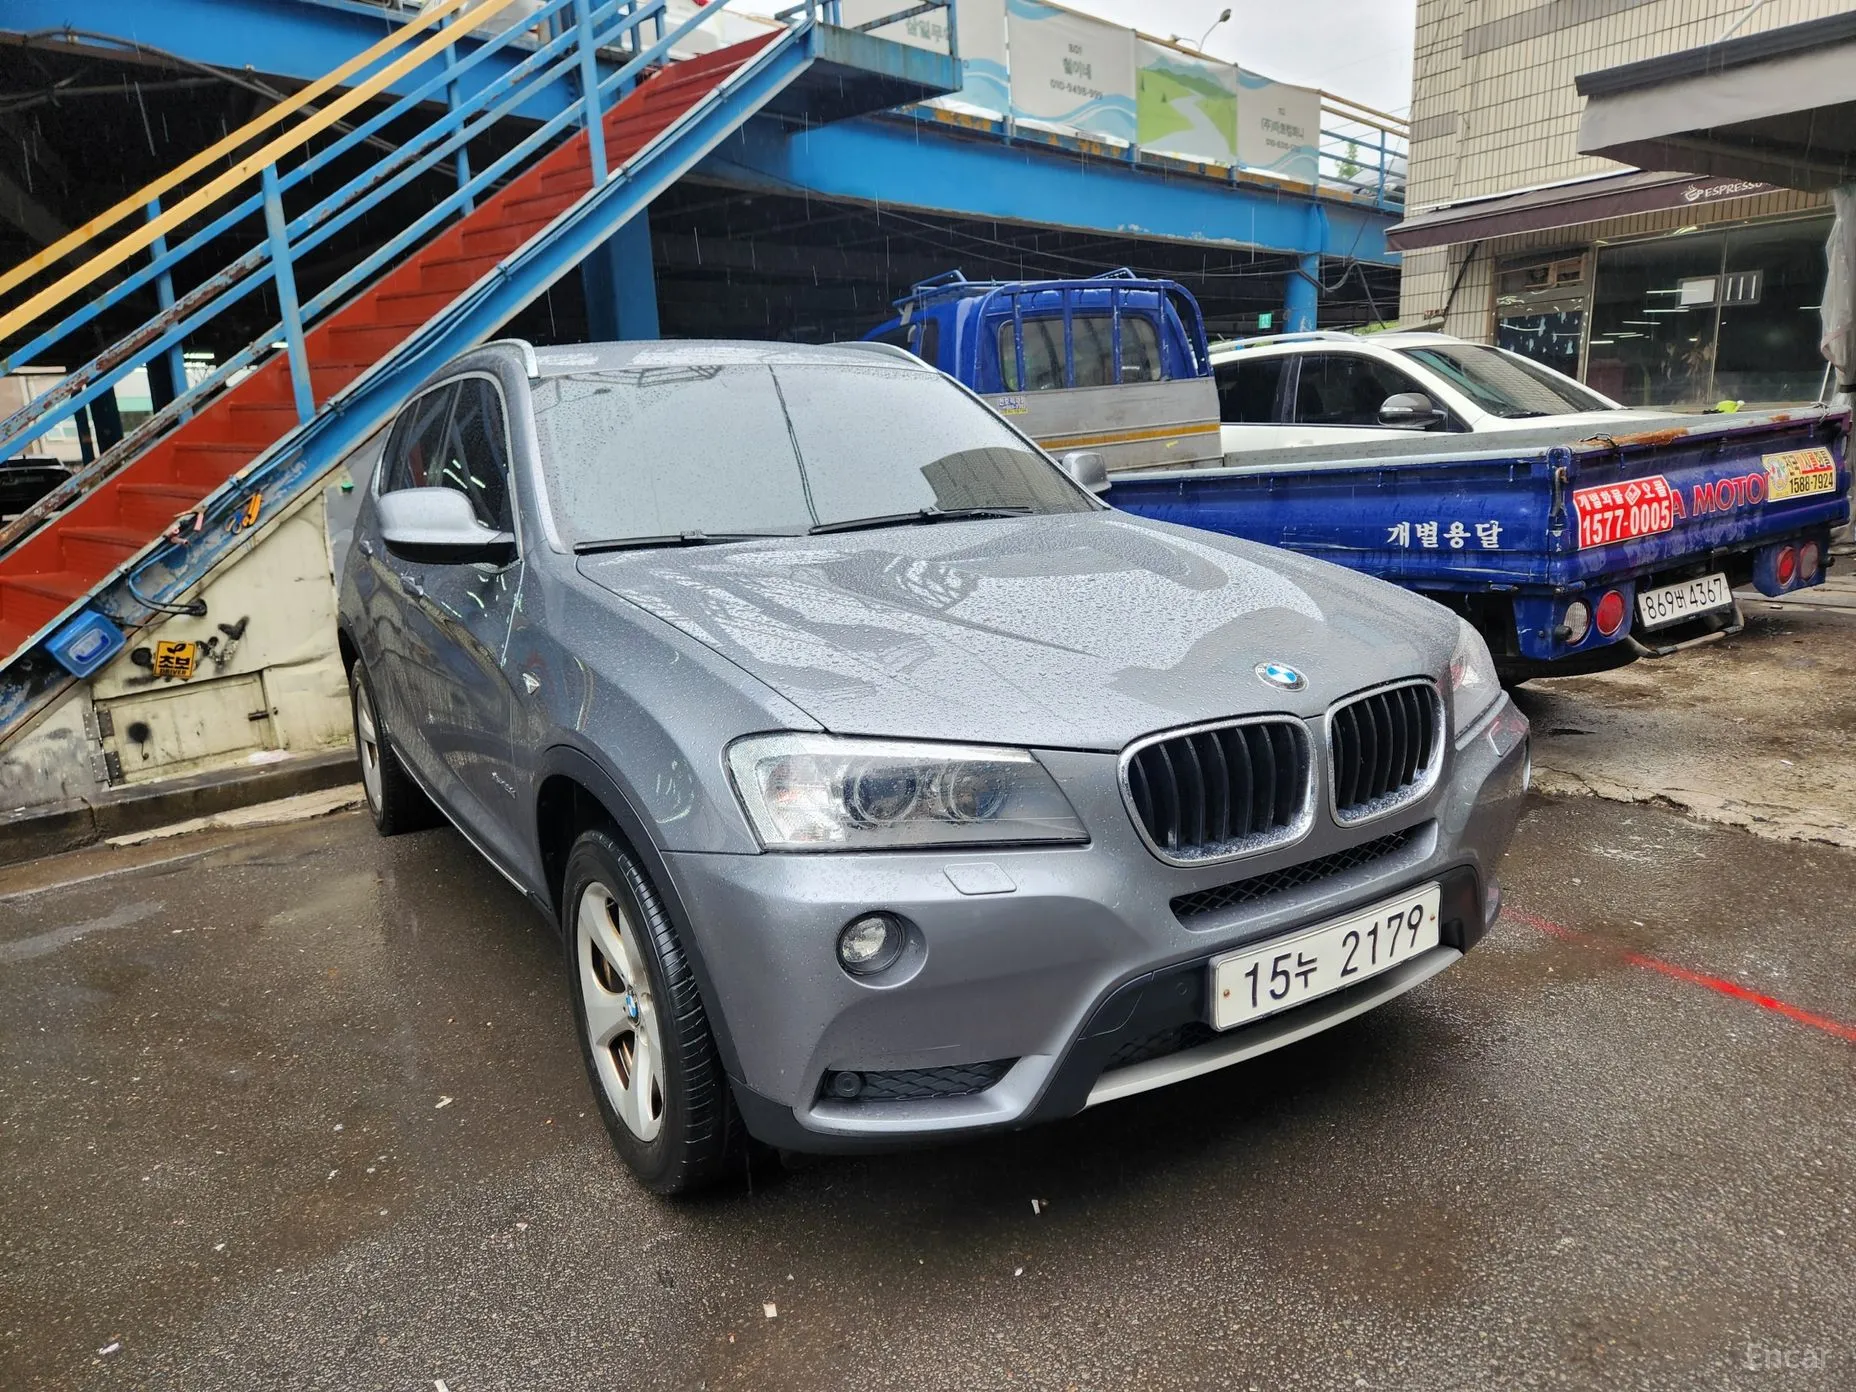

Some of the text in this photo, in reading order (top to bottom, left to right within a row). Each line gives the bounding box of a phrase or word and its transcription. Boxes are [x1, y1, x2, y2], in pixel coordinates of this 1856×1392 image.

[1790, 473, 1834, 494] 1588-7924
[1386, 520, 1503, 549] 개별용달
[1583, 500, 1670, 545] 1577-0005
[1689, 577, 1723, 608] 4367
[158, 655, 191, 670] 초보
[1244, 903, 1424, 1009] 15누 2179
